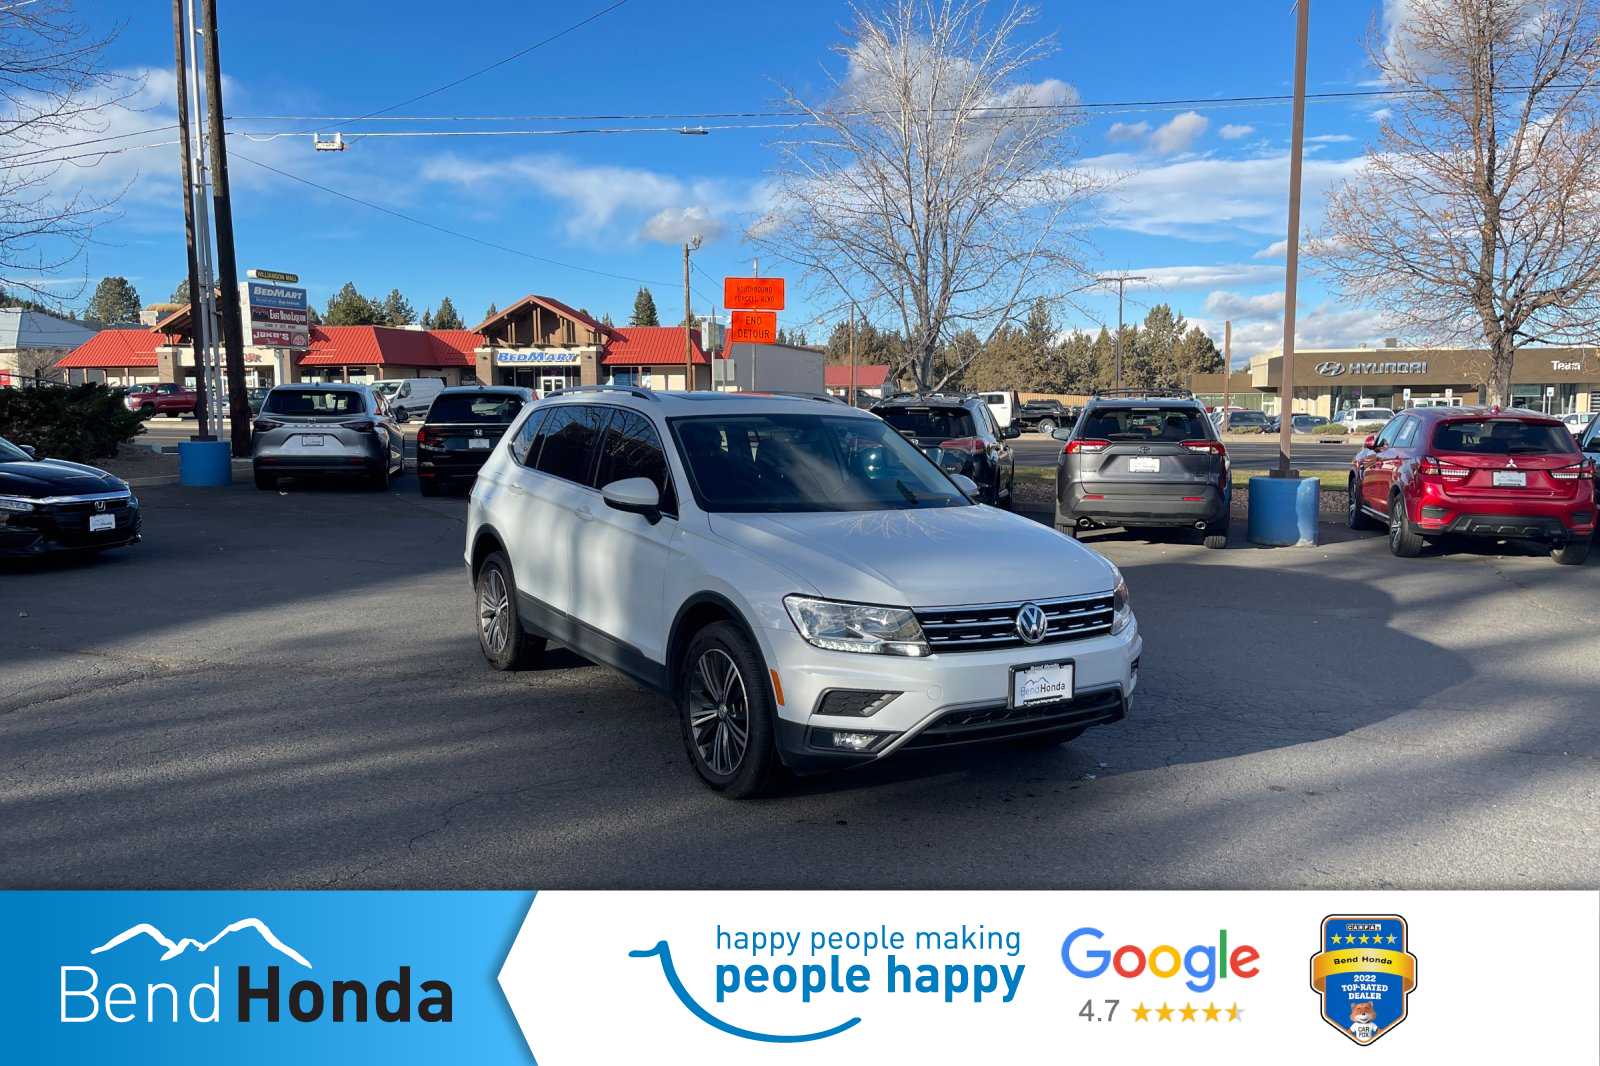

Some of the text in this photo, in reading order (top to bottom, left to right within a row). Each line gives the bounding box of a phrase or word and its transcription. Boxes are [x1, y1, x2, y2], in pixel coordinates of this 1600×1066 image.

[253, 286, 303, 300] BEDMART
[745, 316, 762, 326] END
[737, 328, 770, 339] DETOUR
[497, 351, 578, 362] BEDMART
[1348, 361, 1428, 375] HYUNDAI
[1550, 360, 1581, 371] Team
[1040, 682, 1066, 693] Honda
